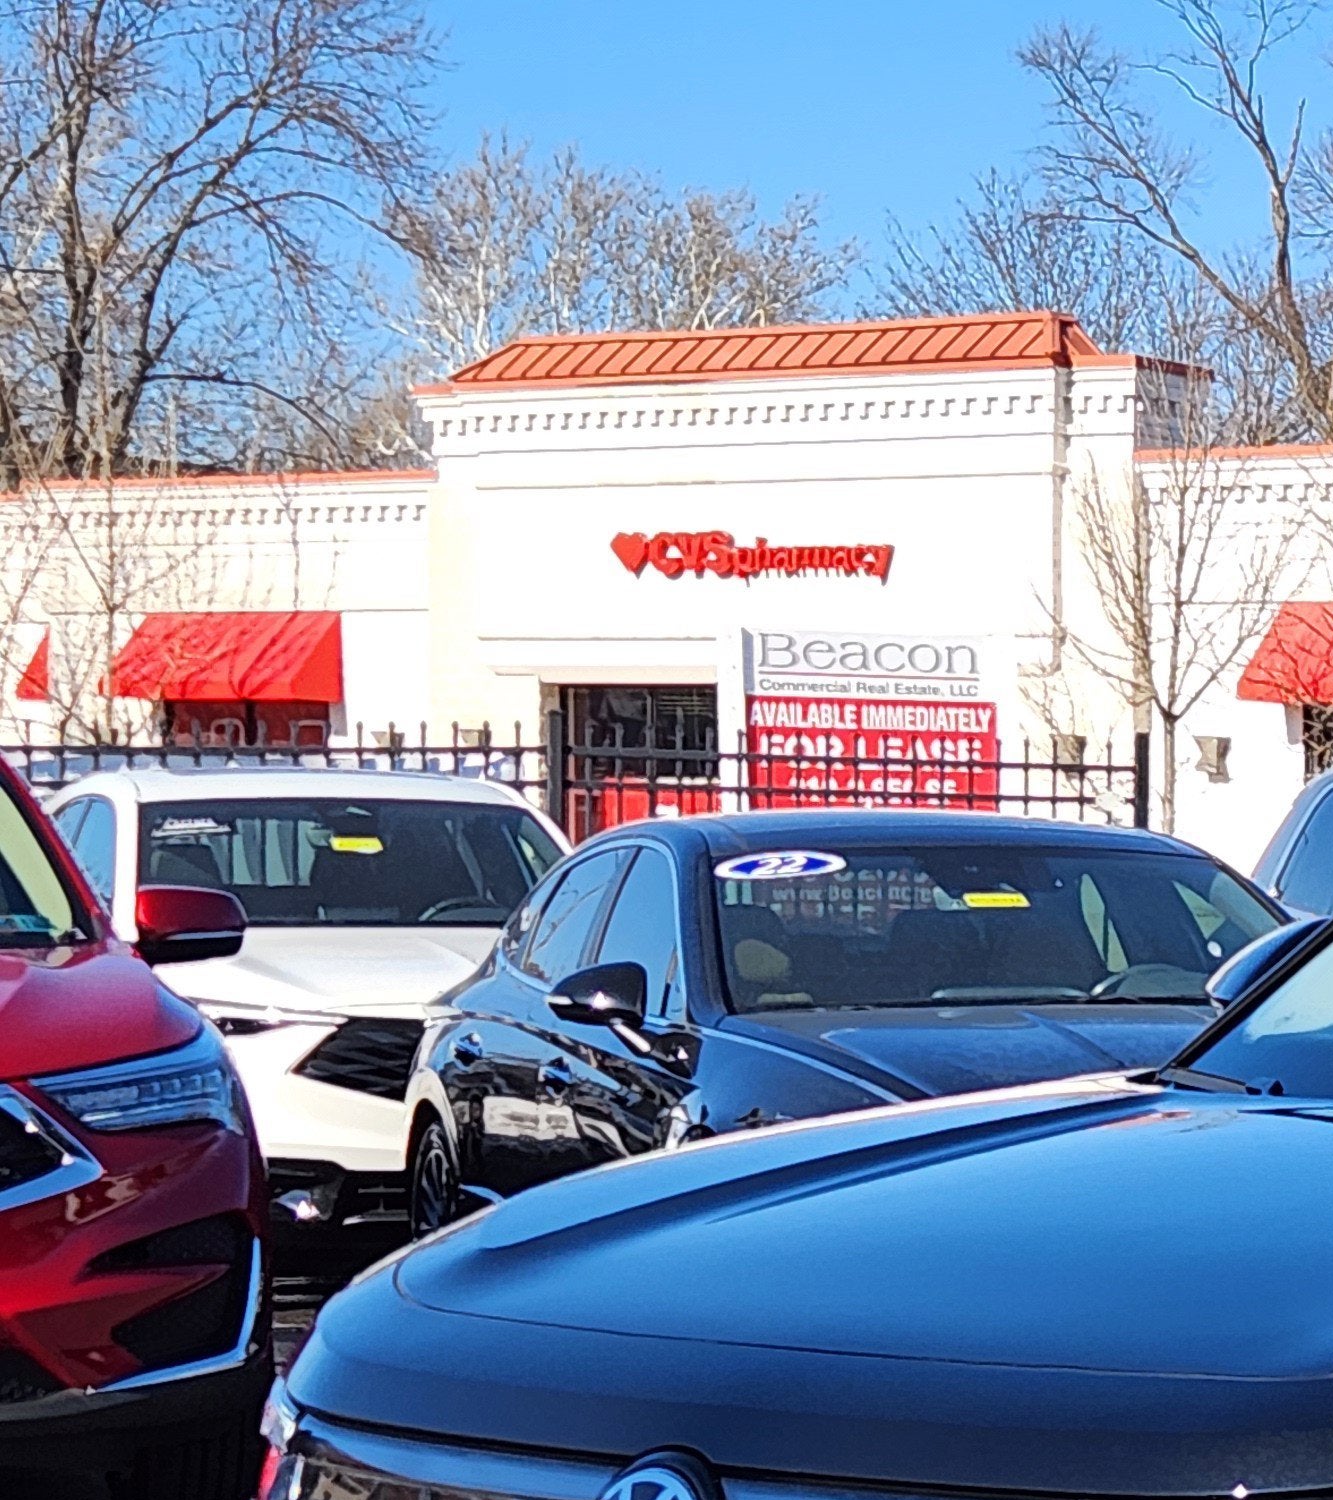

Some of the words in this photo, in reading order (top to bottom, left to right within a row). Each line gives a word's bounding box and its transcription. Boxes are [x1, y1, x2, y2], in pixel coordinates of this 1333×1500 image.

[759, 632, 980, 674] Beacon
[759, 678, 851, 694] Commercial
[856, 682, 889, 694] Real
[894, 683, 945, 697] Estate,
[949, 684, 979, 697] LLC
[750, 700, 858, 729] AVAILABLE
[861, 704, 992, 733] IMMEDIATELY
[756, 856, 808, 875] 22
